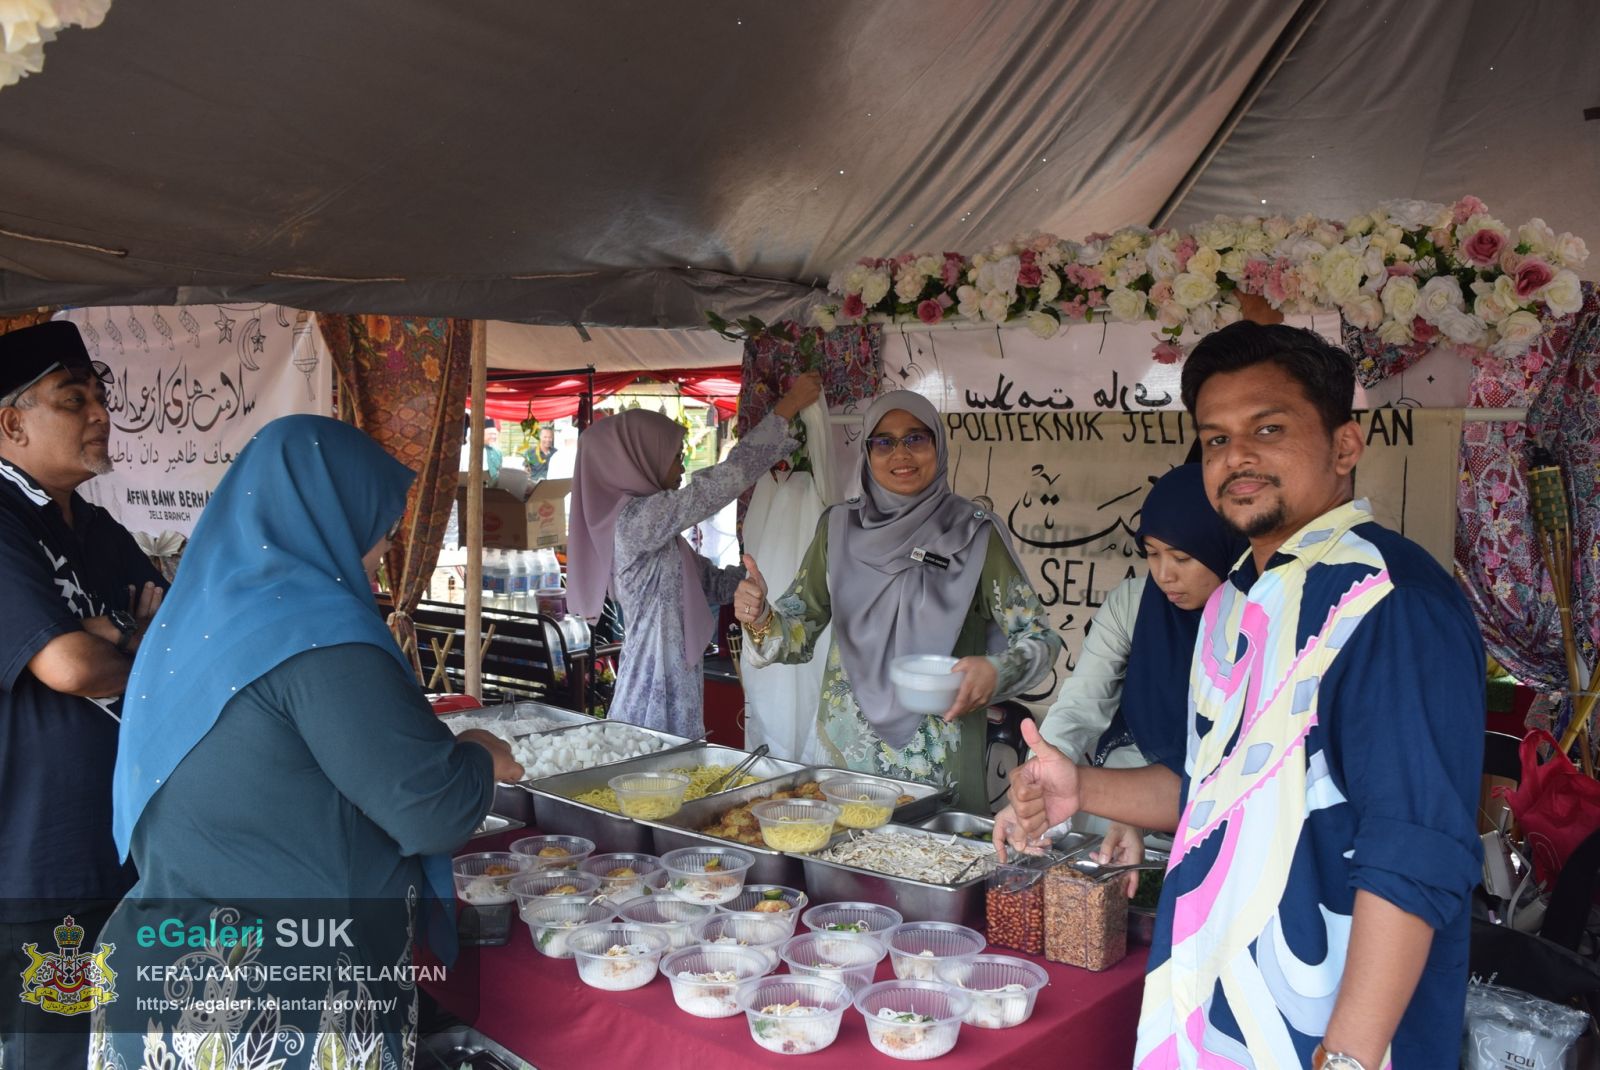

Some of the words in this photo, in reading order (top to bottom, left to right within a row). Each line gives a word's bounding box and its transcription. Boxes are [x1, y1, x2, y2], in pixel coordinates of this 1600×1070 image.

[192, 362, 257, 433] سلامت
[947, 412, 1104, 442] POLITEKNIK
[1121, 411, 1185, 445] JELI
[1351, 409, 1414, 446] TAN
[140, 442, 159, 465] دان
[126, 487, 151, 506] AFFIN
[151, 489, 176, 507] BANK
[178, 489, 213, 508] BERHA
[148, 509, 163, 520] JELI
[163, 510, 191, 521] BRANCH
